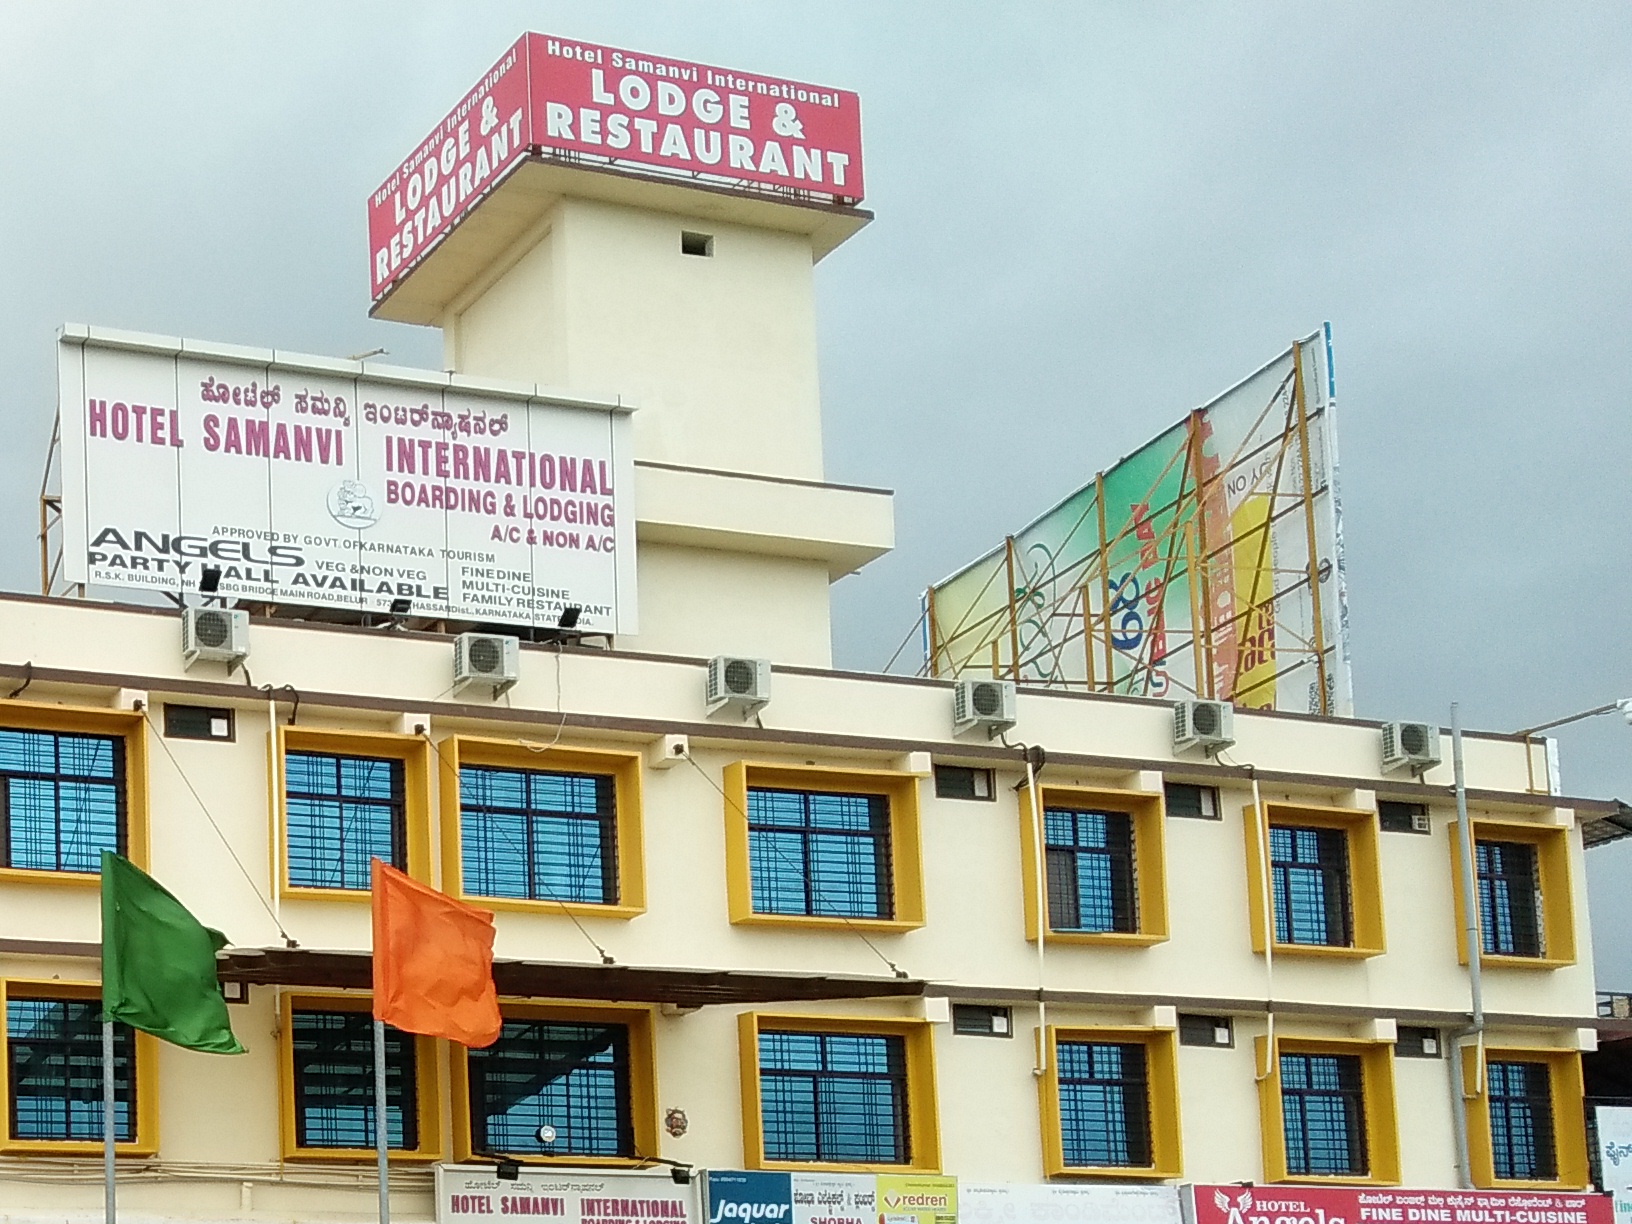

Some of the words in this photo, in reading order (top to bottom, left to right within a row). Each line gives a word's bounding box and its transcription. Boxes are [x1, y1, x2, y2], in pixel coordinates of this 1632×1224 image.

[547, 40, 603, 64] Hotel
[612, 53, 698, 82] Samanvi
[707, 70, 840, 108] International
[591, 68, 750, 130] LODGE
[772, 102, 806, 139] &
[375, 172, 400, 208] Hotel
[403, 130, 443, 178] Samanvi
[447, 48, 517, 132] International
[546, 102, 849, 187] RESTAURANT
[394, 118, 470, 226] LODGE
[480, 96, 499, 136] &
[376, 108, 522, 285] RESTAURANT
[89, 398, 184, 448] HOTEL
[203, 414, 343, 466] SAMANVI
[385, 435, 614, 496] INTERNATIONAL
[386, 479, 497, 516] BOARDING
[503, 492, 516, 518] &
[523, 494, 614, 528] LODGING
[90, 527, 306, 568] ANGELS
[212, 525, 280, 542] APPROVED
[283, 533, 299, 543] BY
[440, 549, 495, 564] TOURISM
[491, 524, 521, 544] A/C
[526, 528, 537, 546] &
[542, 530, 580, 549] NON
[585, 534, 615, 553] A/C
[88, 551, 193, 575] PARTY
[291, 571, 449, 600] AVAILABLE
[315, 560, 346, 574] VEG
[397, 569, 427, 581] VEG
[461, 566, 494, 580] FINE
[496, 569, 531, 583] DINE
[462, 580, 570, 600] MULTI-CUISINE
[94, 570, 125, 581] R.S.K.
[127, 574, 179, 588] BUILDING,
[182, 579, 196, 588] NH
[241, 584, 279, 596] BRIDGE
[280, 588, 306, 599] MAIN
[475, 607, 531, 620] KARNATAKA
[463, 593, 515, 608] FAMILY
[517, 598, 612, 617] RESTAURANT
[451, 1194, 493, 1214] HOTEL
[501, 1196, 565, 1216] SAMANVI
[581, 1198, 686, 1218] INTERNATIONAL
[710, 1199, 789, 1223] Jaquar
[902, 1193, 947, 1206] redren
[1256, 1200, 1311, 1213] HOTEL
[1360, 1207, 1404, 1221] FINE
[1407, 1209, 1452, 1222] DINE
[1456, 1210, 1587, 1224] MULTI-CUISINE
